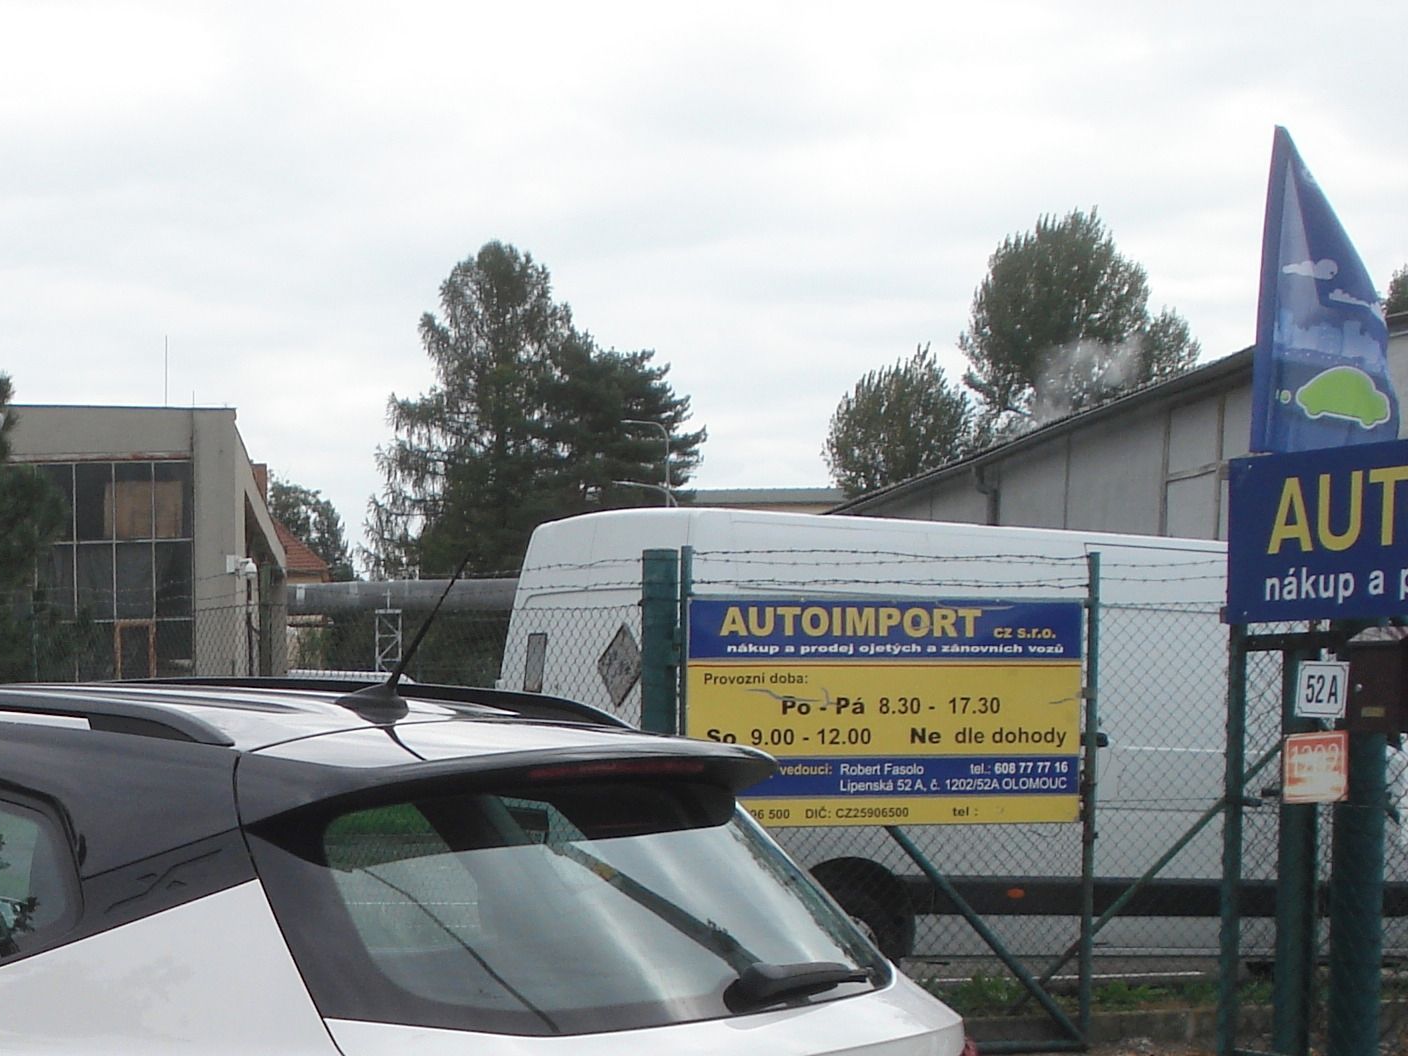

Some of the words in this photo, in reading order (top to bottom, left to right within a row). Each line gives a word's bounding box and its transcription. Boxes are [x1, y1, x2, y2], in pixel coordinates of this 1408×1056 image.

[1267, 465, 1408, 555] AUT
[1265, 566, 1355, 604] nákup
[1368, 569, 1384, 595] a
[719, 606, 982, 638] AUTOIMPORT
[1017, 627, 1057, 639] s.r.o.
[727, 643, 780, 655] nákup
[784, 644, 795, 653] a
[800, 643, 854, 655] prodej
[859, 643, 921, 655] ojetých
[927, 644, 937, 653] a
[941, 643, 1023, 654] zánovních
[1028, 643, 1064, 654] vozů
[703, 672, 765, 685] Provozní
[769, 672, 809, 685] doba:
[781, 696, 811, 715] Po
[835, 697, 865, 715] Pá
[879, 697, 921, 715] 8.30
[948, 697, 1001, 715] 17.30
[706, 728, 737, 745] So
[751, 728, 795, 746] 9.00
[817, 728, 872, 745] 12.00
[910, 727, 942, 744] Ne
[954, 727, 985, 744] dle
[992, 727, 1067, 748] dohody
[839, 763, 881, 775] Robert
[884, 763, 925, 775] Fasolo
[994, 762, 1016, 774] 608
[1019, 762, 1035, 774] 77
[1037, 762, 1051, 773] 77
[1055, 761, 1069, 773] 16
[839, 779, 894, 793] Lipenská
[896, 779, 912, 791] 52
[945, 778, 1000, 791] 1202/52A
[1002, 777, 1068, 790] OLOMOUC
[768, 809, 790, 820] 500
[805, 806, 831, 819] DIČ:
[835, 807, 909, 819] CZ25906500
[953, 807, 969, 817] tel
